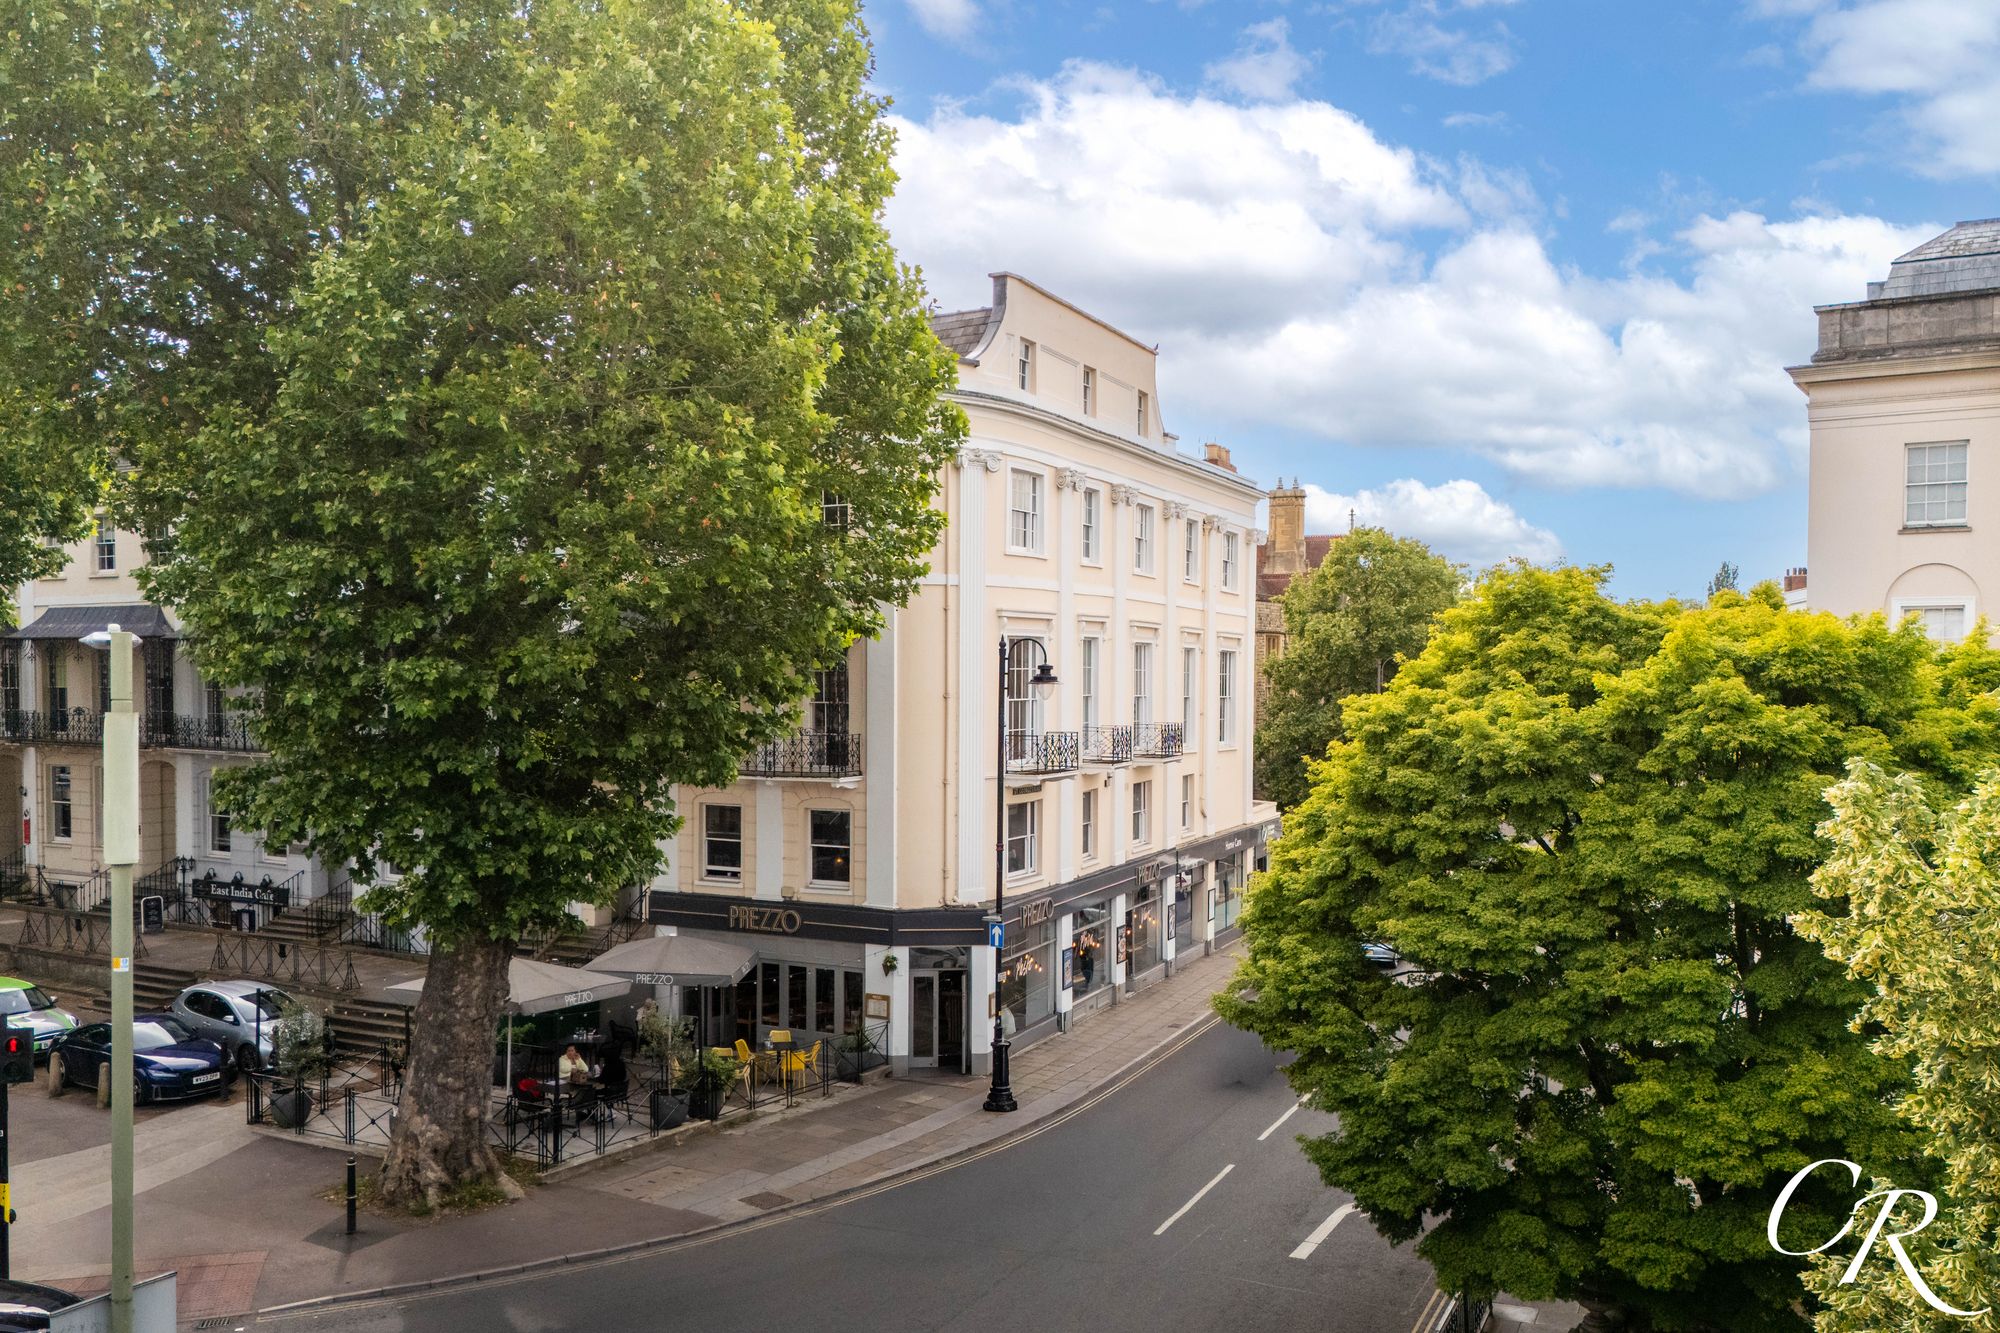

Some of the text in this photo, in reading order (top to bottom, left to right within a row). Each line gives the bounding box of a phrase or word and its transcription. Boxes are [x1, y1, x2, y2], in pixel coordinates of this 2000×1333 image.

[1135, 861, 1161, 887] PREZZO
[210, 884, 229, 896] East
[230, 886, 253, 899] India
[729, 905, 802, 934] PREZZO
[1021, 897, 1054, 929] PREZZO
[636, 973, 674, 985] PREZZO
[564, 991, 594, 1007] PREZZO
